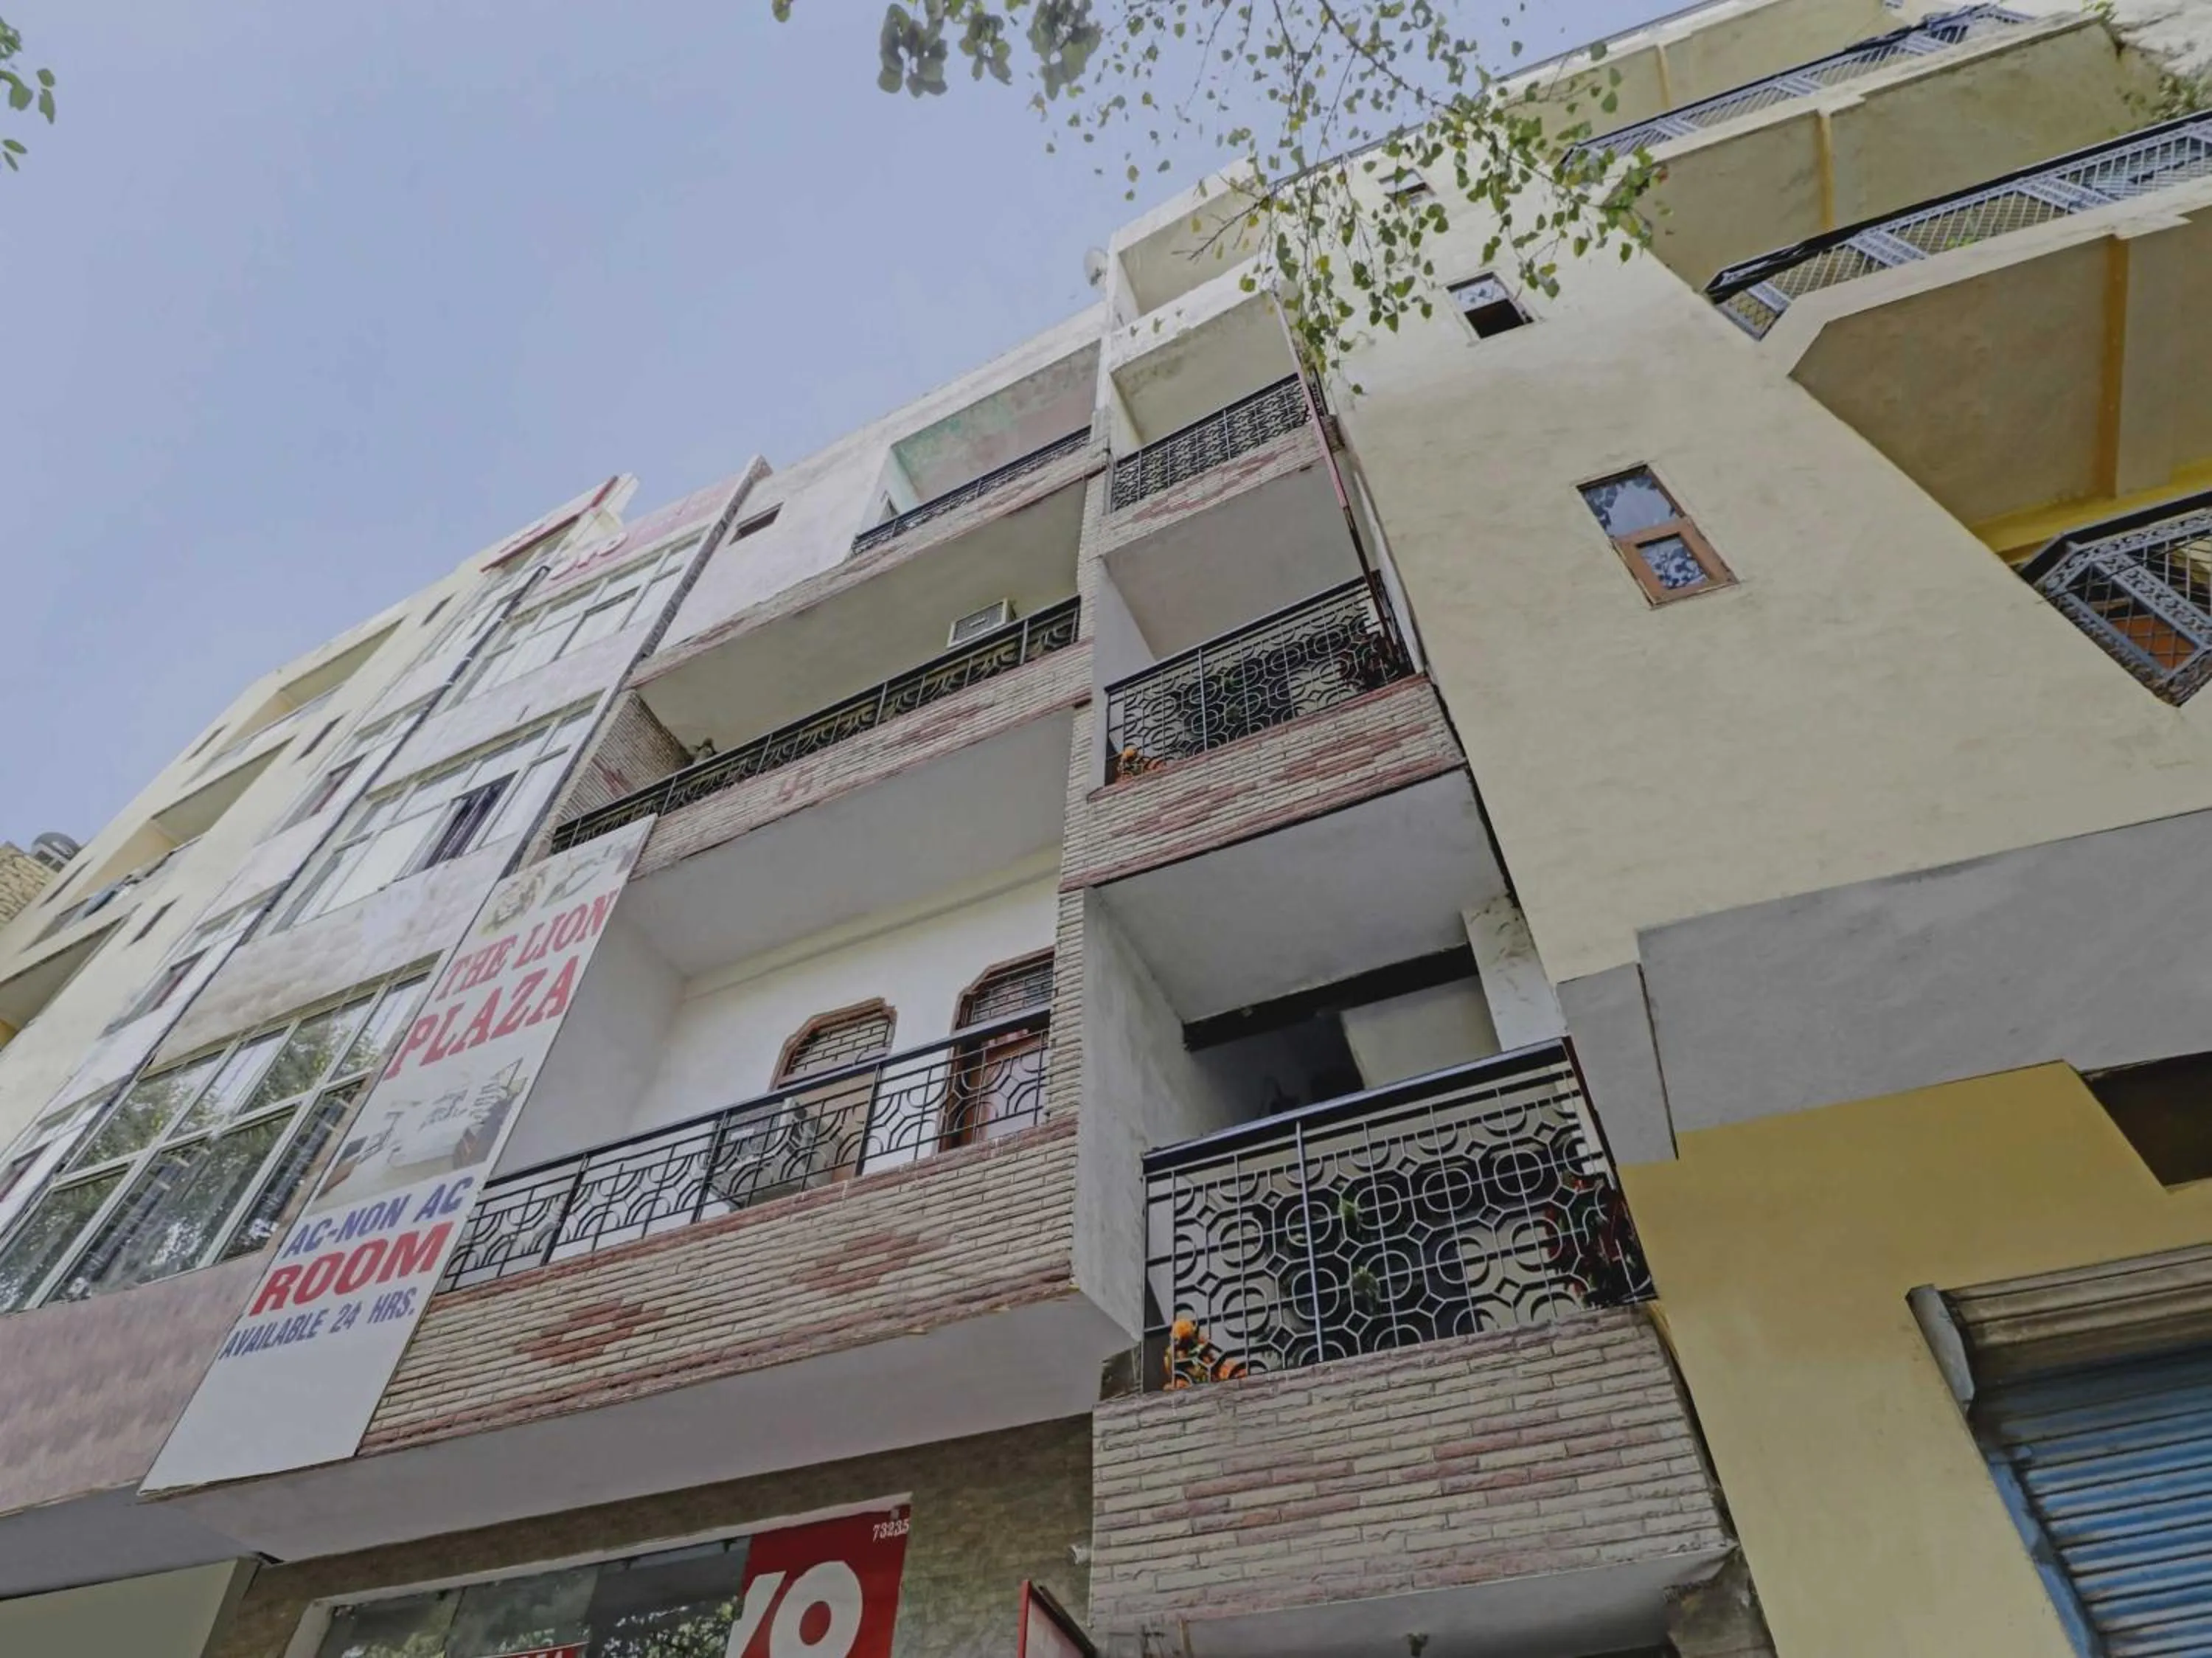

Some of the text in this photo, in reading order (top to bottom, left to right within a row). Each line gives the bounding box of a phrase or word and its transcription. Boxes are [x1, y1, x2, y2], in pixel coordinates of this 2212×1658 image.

[435, 888, 619, 1001] THE LION
[382, 955, 580, 1081] PLAZA
[282, 1176, 474, 1258] AC-NON AC
[248, 1221, 454, 1317] ROOM
[218, 1287, 418, 1359] AVAILABLE 24 HRS.
